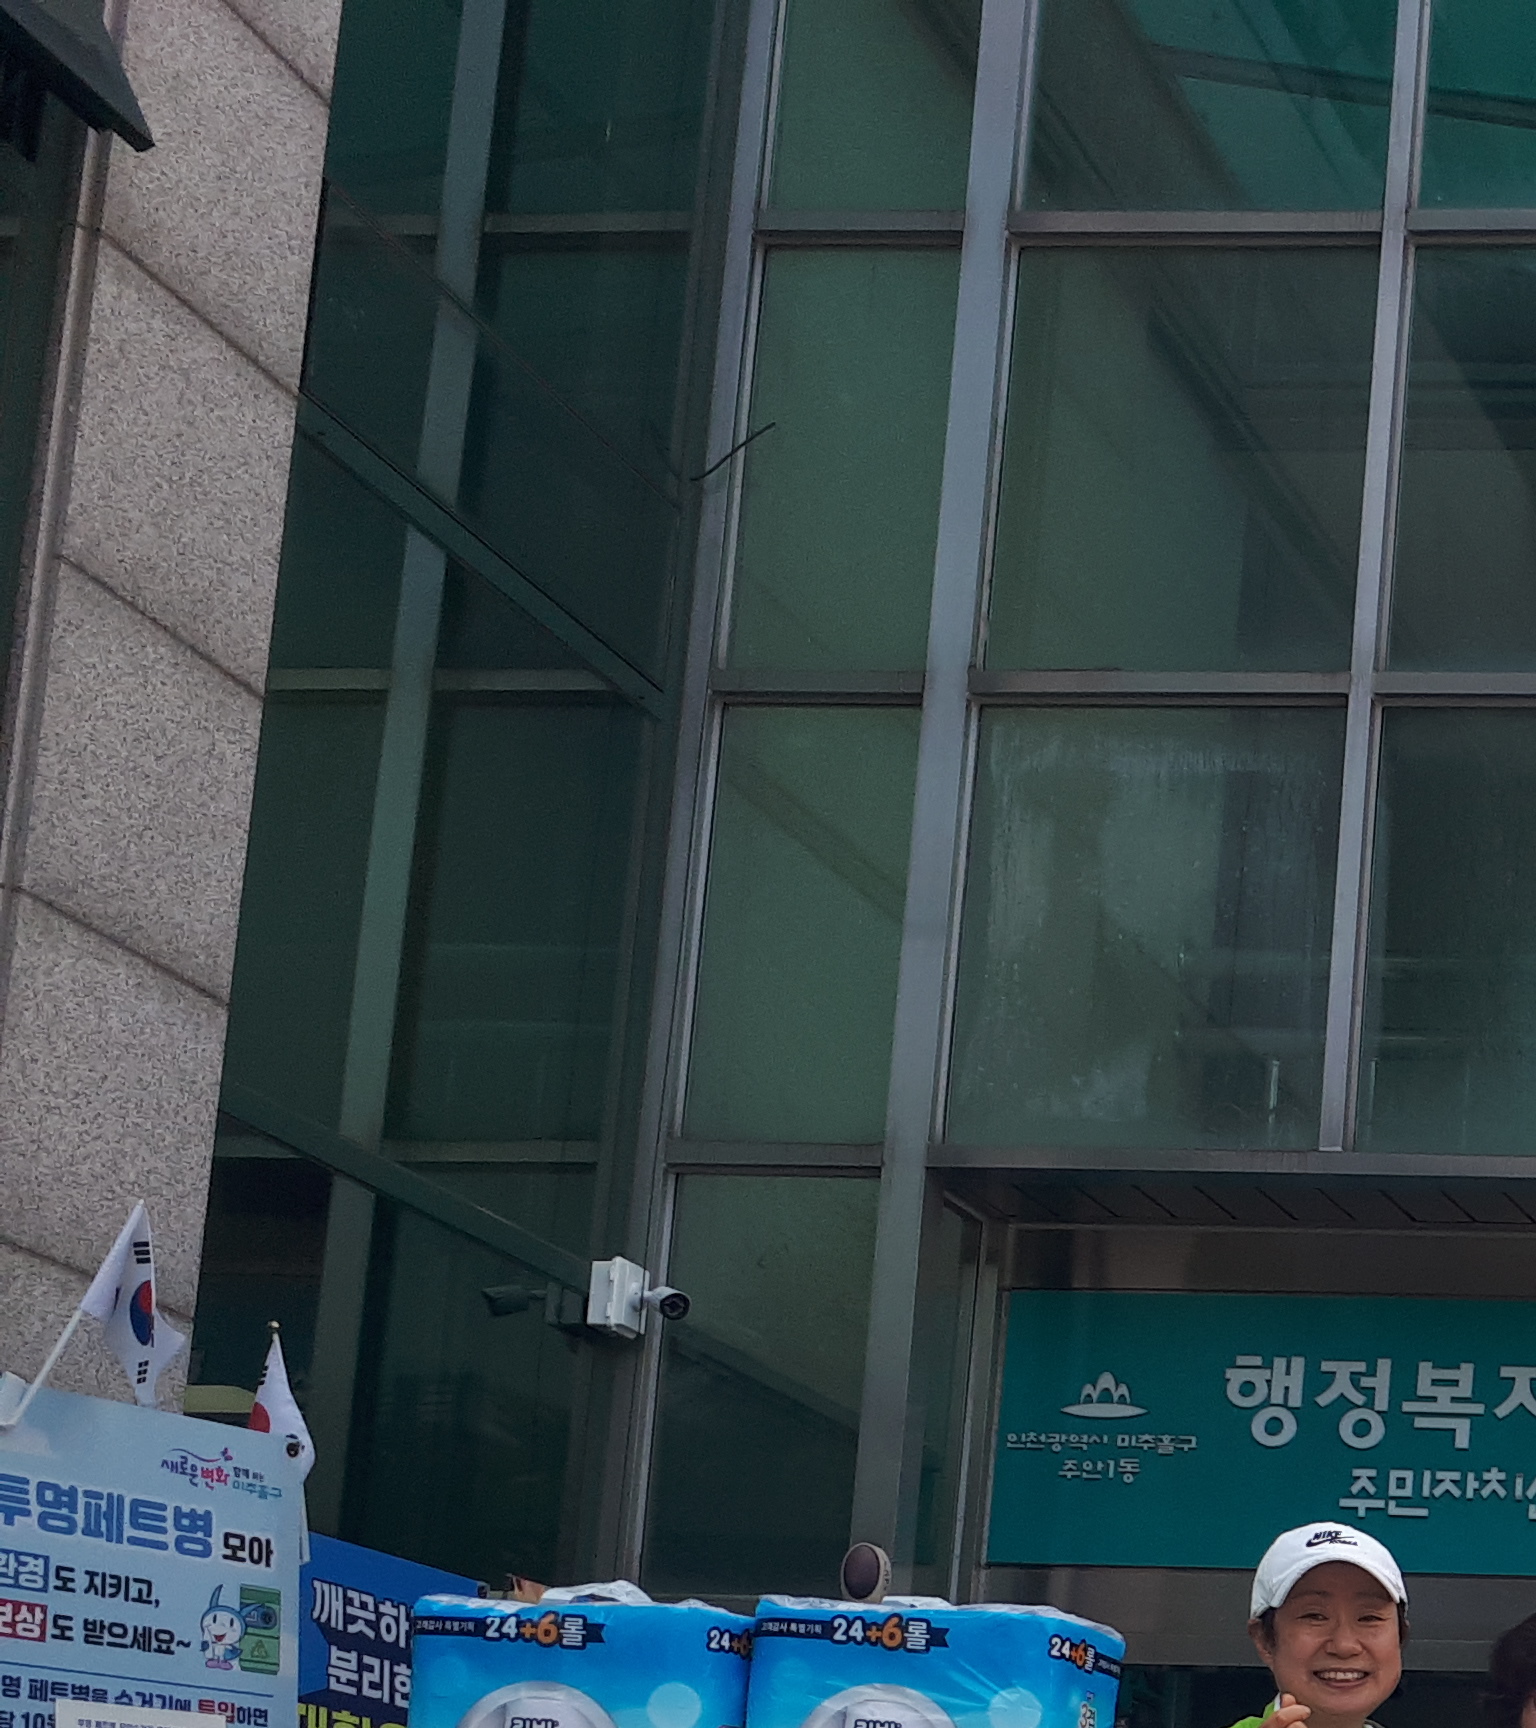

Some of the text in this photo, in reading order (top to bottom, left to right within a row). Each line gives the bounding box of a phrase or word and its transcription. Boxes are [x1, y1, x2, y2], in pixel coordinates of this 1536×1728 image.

[1006, 1431, 1198, 1455] 인천광역시 미추홀구
[1058, 1457, 1141, 1484] 주안1동
[222, 1531, 275, 1568] 모아
[1313, 1530, 1342, 1541] NIKE
[84, 1570, 160, 1608] 지키고,
[485, 1613, 588, 1647] 24+6롤
[832, 1615, 931, 1650] 24+6롤
